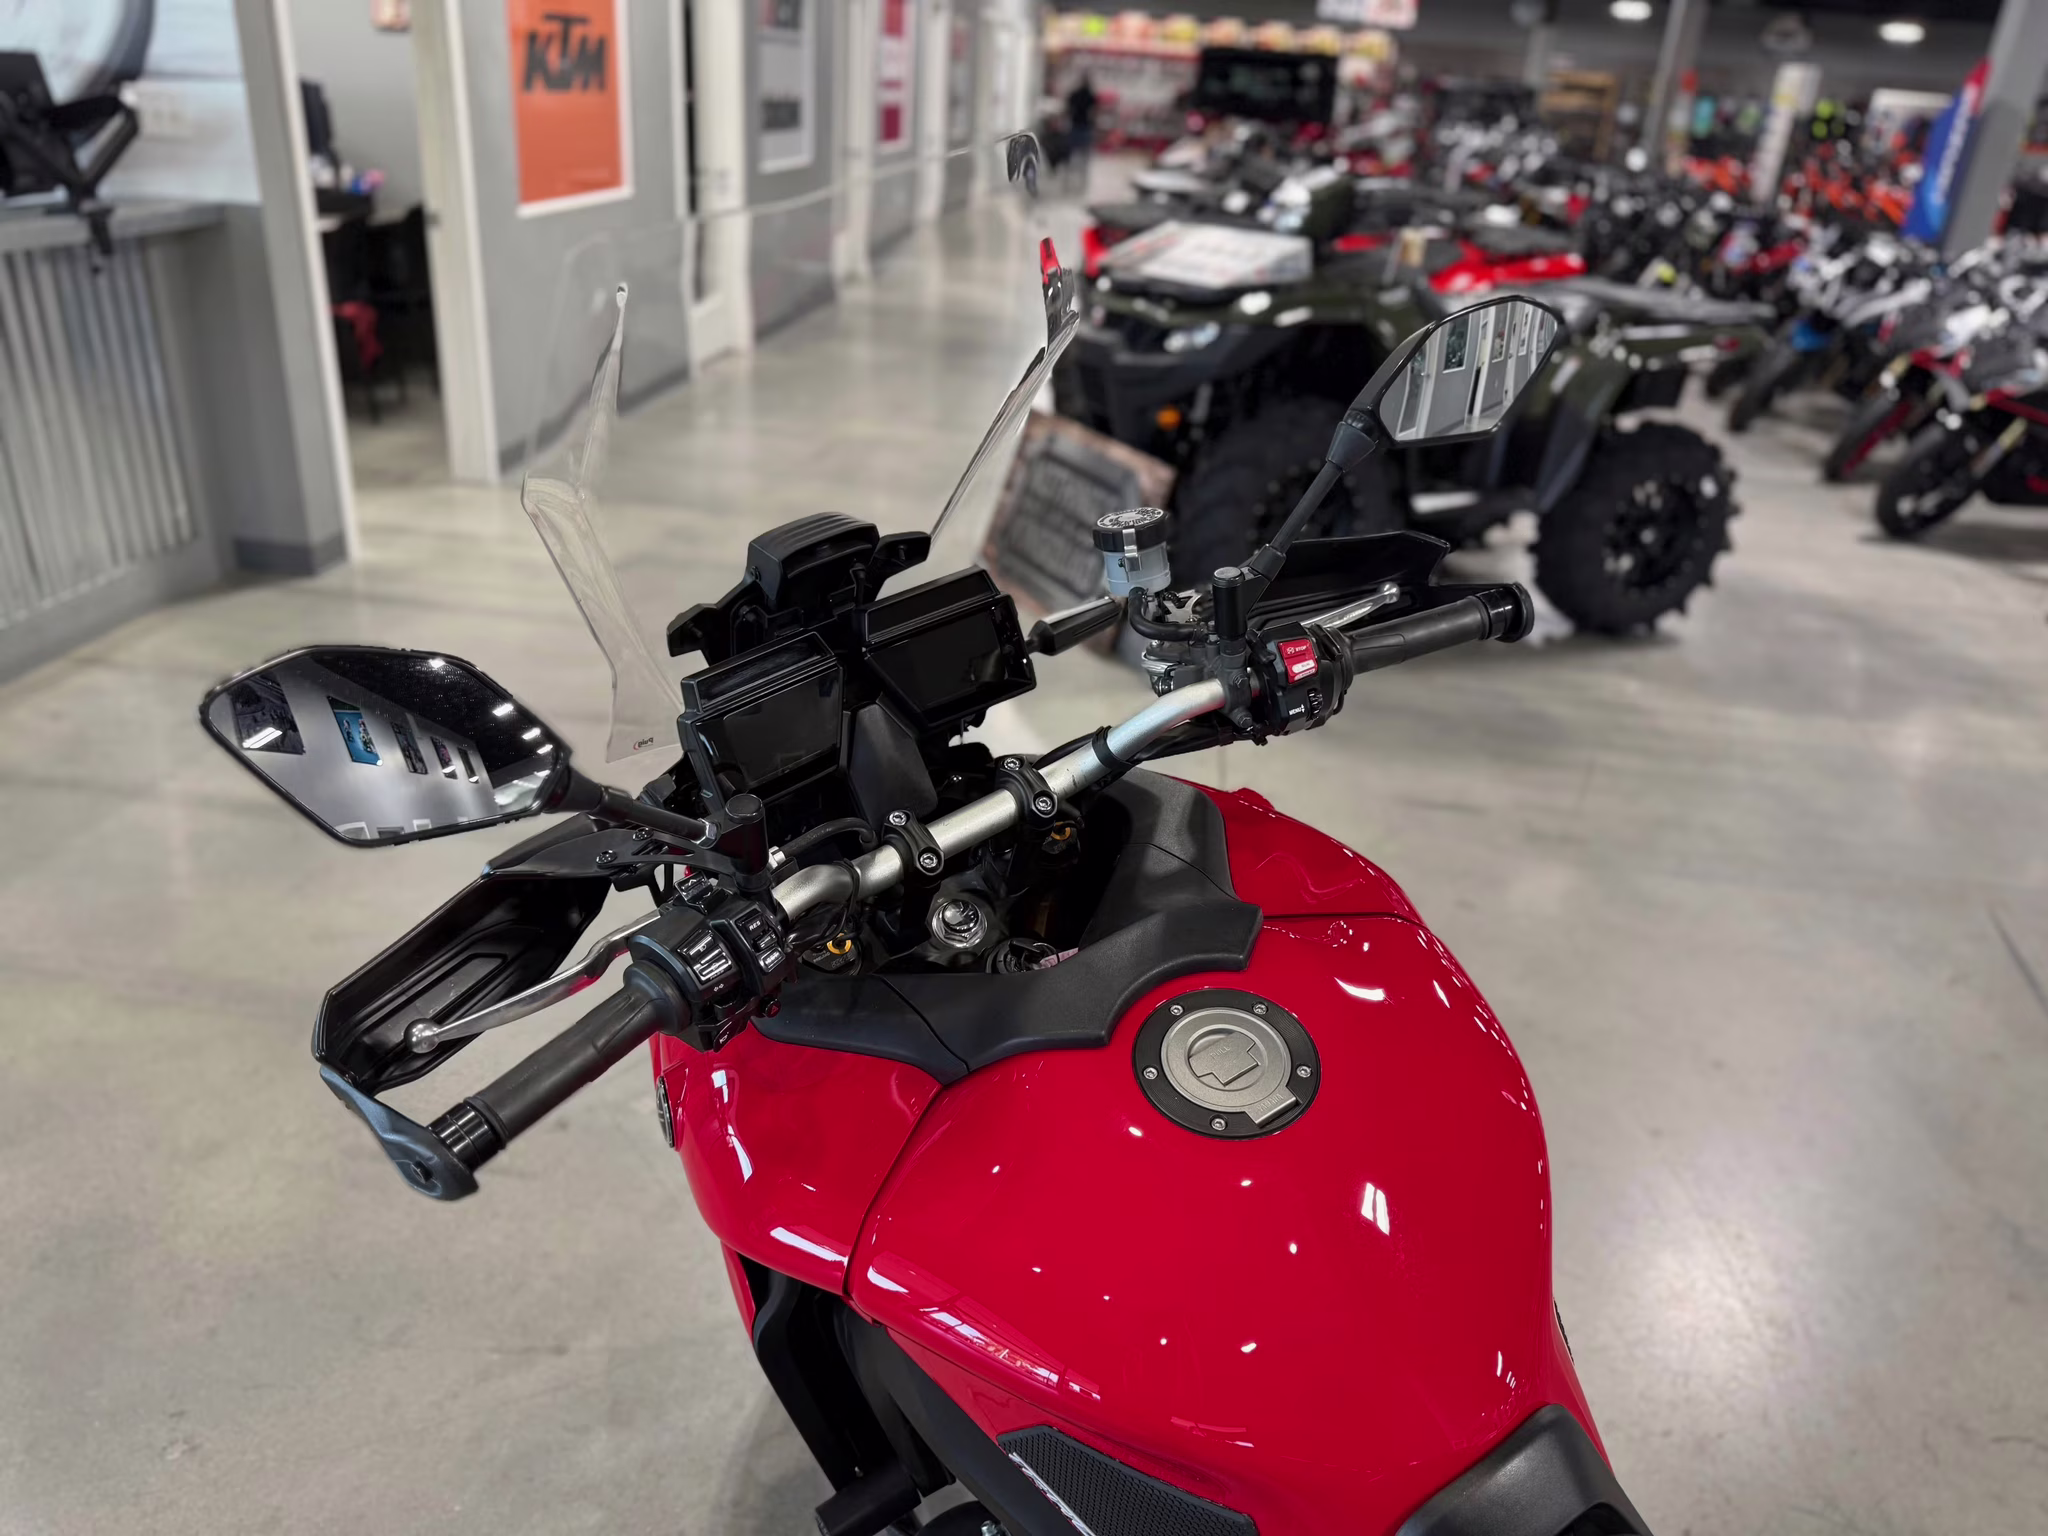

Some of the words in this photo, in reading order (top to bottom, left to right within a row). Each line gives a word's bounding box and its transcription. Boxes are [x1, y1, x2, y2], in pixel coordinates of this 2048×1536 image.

[523, 13, 607, 93] KTM
[1288, 706, 1302, 715] MENU
[748, 920, 761, 931] RES
[1210, 1045, 1231, 1060] PULL
